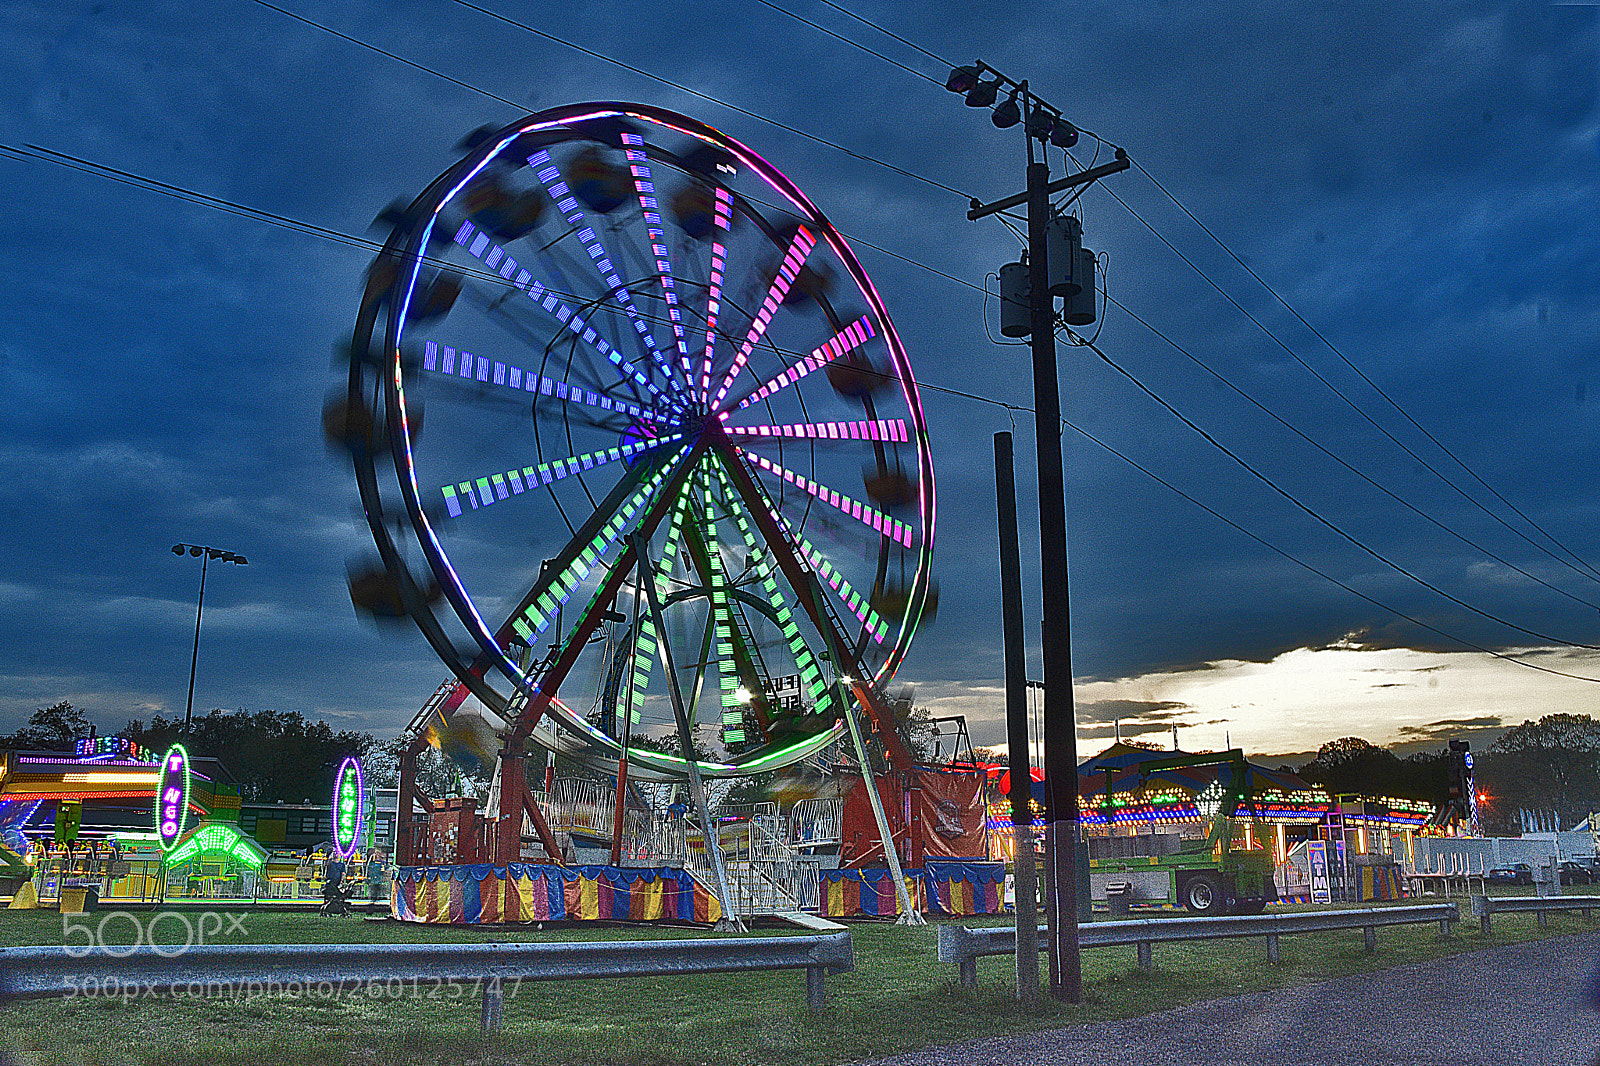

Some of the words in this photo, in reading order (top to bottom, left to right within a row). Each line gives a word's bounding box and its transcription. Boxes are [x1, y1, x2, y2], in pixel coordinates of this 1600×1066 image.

[75, 736, 160, 763] ENTERPRISE
[161, 755, 184, 836] TNGO
[1313, 851, 1327, 889] ATM
